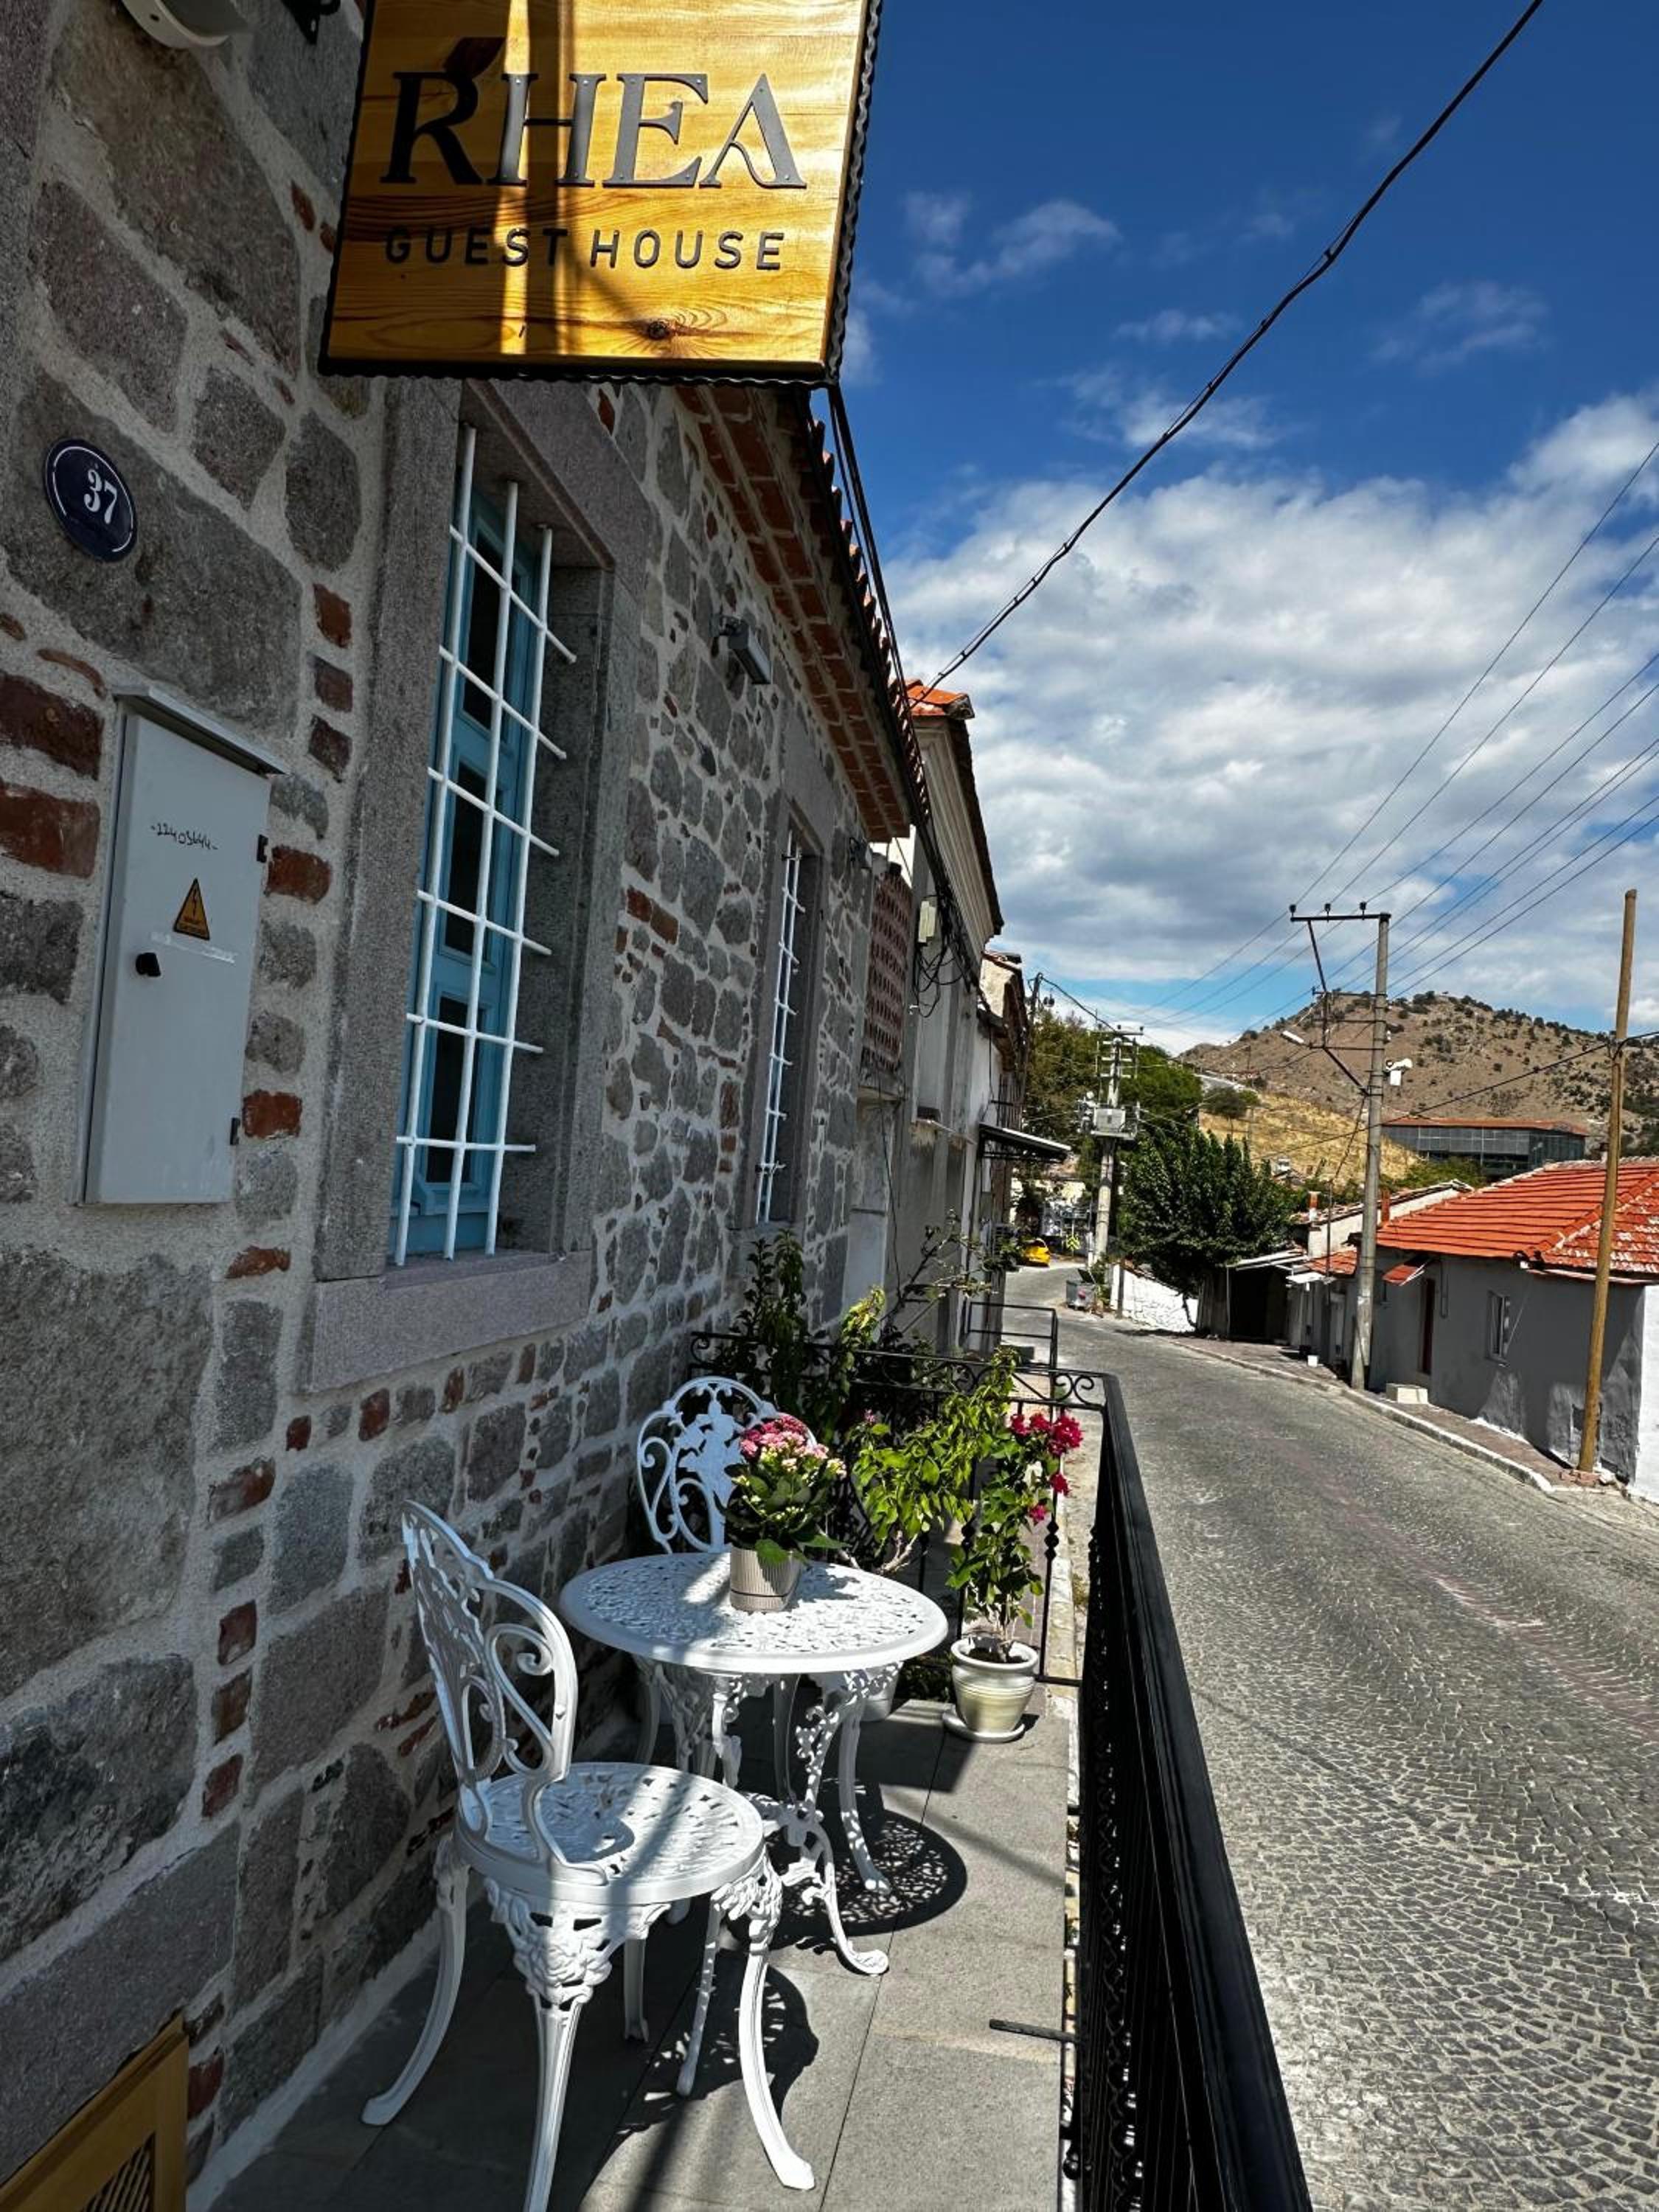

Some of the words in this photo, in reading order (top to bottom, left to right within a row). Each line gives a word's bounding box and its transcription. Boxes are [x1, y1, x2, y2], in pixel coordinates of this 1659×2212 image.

[380, 72, 807, 189] RHEA
[385, 227, 568, 268] GUEST
[590, 229, 785, 271] HOUSE
[83, 468, 118, 525] 37
